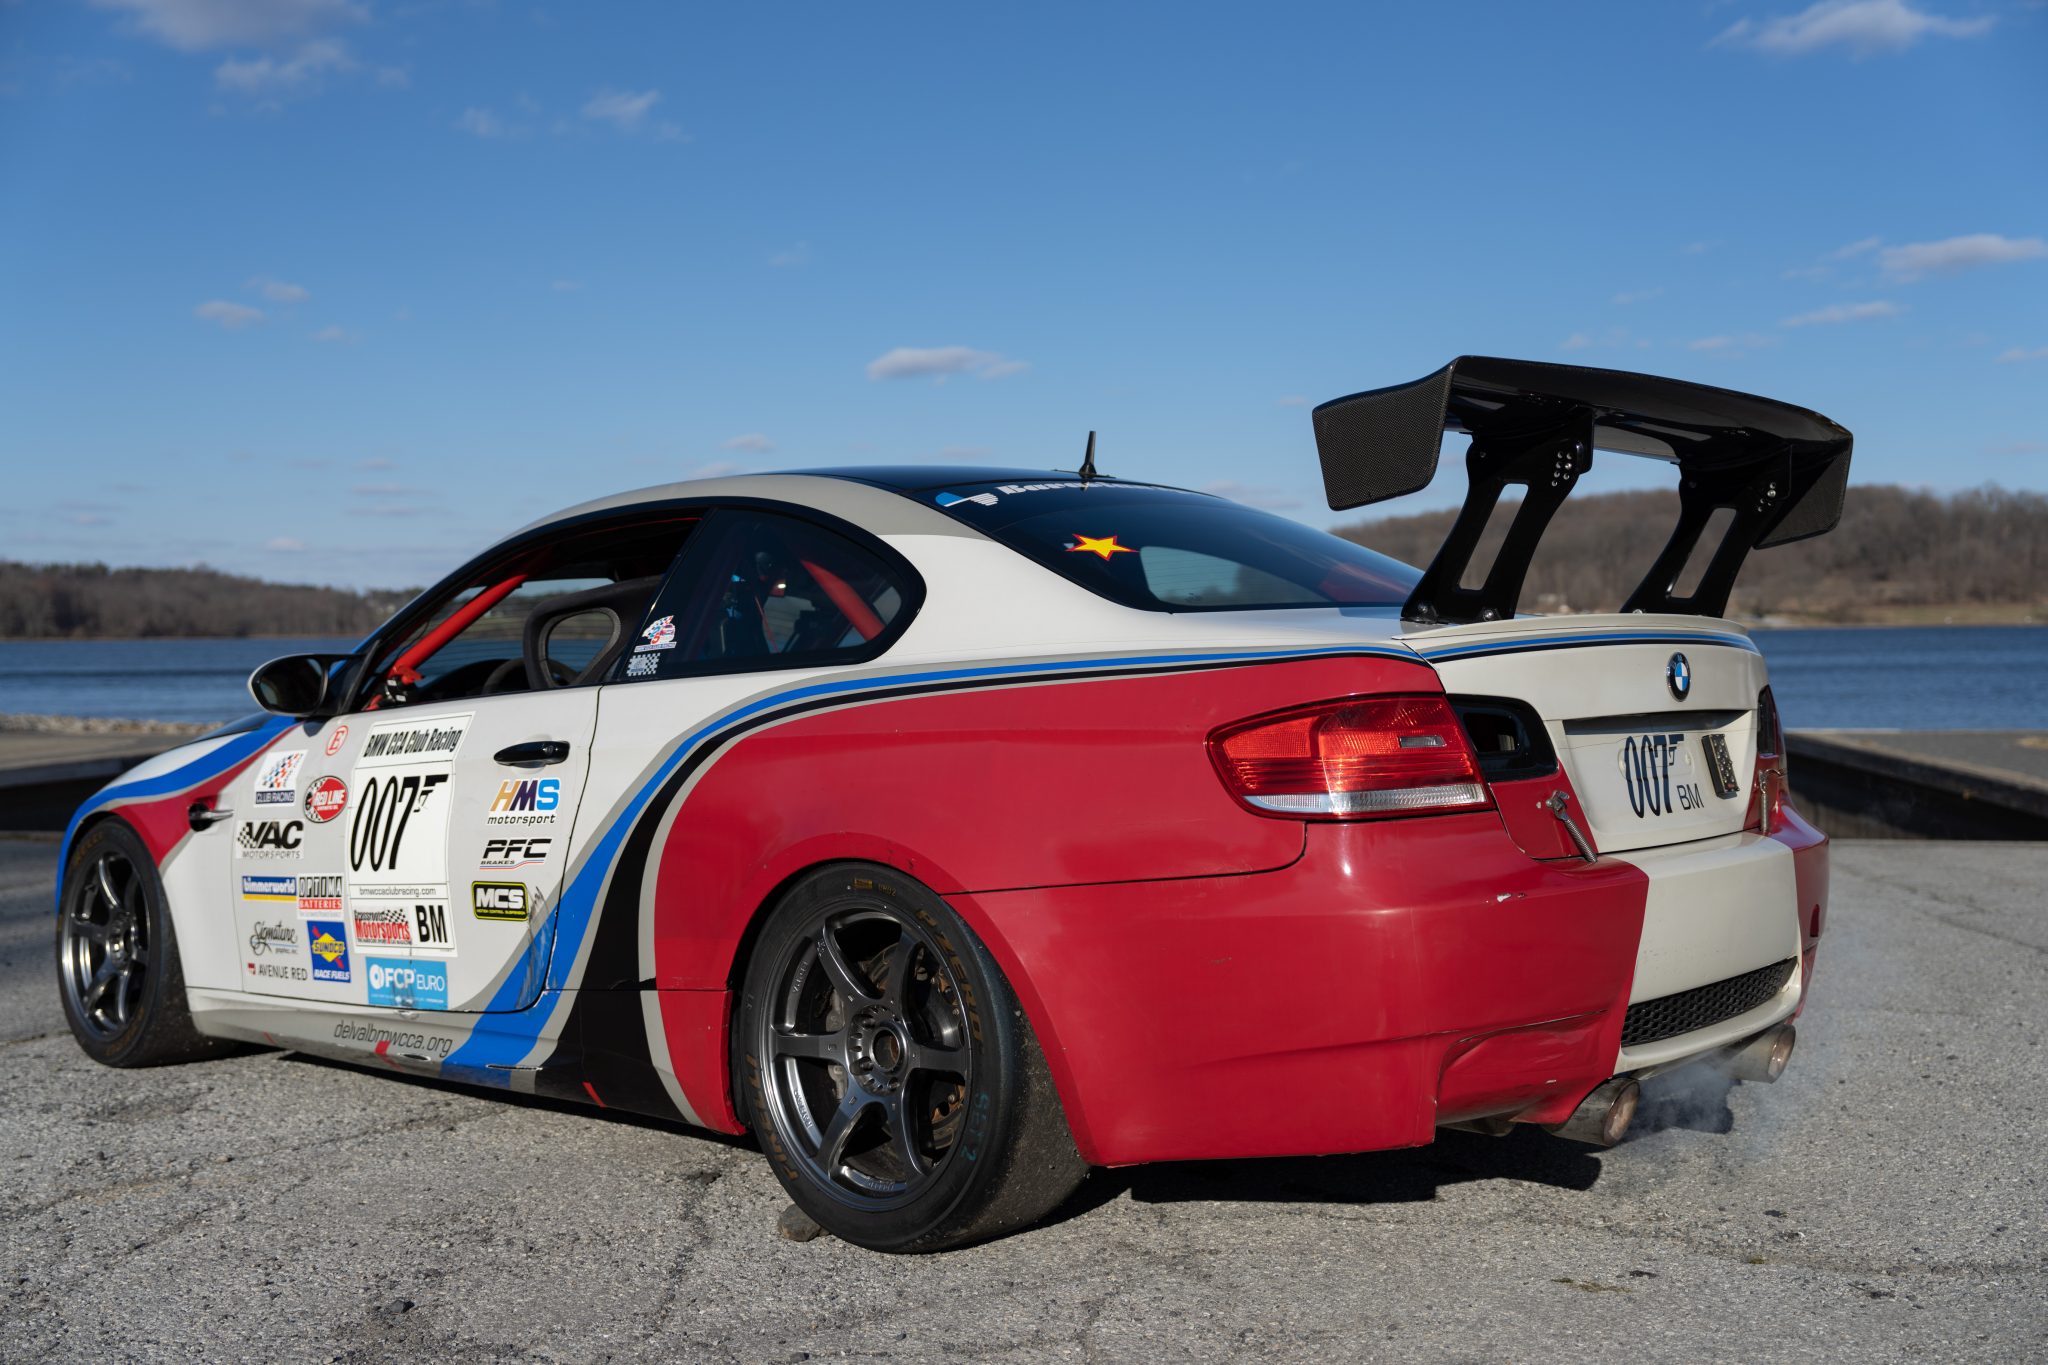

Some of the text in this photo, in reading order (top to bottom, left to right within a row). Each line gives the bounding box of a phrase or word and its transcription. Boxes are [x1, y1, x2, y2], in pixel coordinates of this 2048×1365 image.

[363, 726, 463, 757] BMW CCA Club Racing
[1624, 734, 1673, 818] 007
[256, 790, 294, 804] CLUB RACING
[313, 789, 345, 806] RED LINE
[490, 779, 560, 811] HMS
[1676, 783, 1704, 810] BM
[350, 775, 421, 872] 007
[487, 814, 556, 827] motorsport
[243, 820, 304, 849] VAC
[242, 850, 300, 860] MOTORSPORTS
[483, 838, 552, 859] PFC
[243, 877, 296, 894] bimmerworld
[299, 876, 342, 898] OPTIMA
[359, 886, 436, 898] bmwccaclubracing.com
[299, 898, 342, 909] BATTERIES
[476, 887, 524, 909] MCS
[354, 918, 411, 944] Motorsports
[415, 905, 448, 943] BM
[250, 920, 298, 957] Signature
[314, 942, 344, 954] SUNOCO
[259, 963, 308, 981] AVENUE RED
[314, 968, 350, 981] RACE FUELS
[384, 967, 445, 992] FCP EURO
[334, 1020, 453, 1058] delvalbmwcca.org
